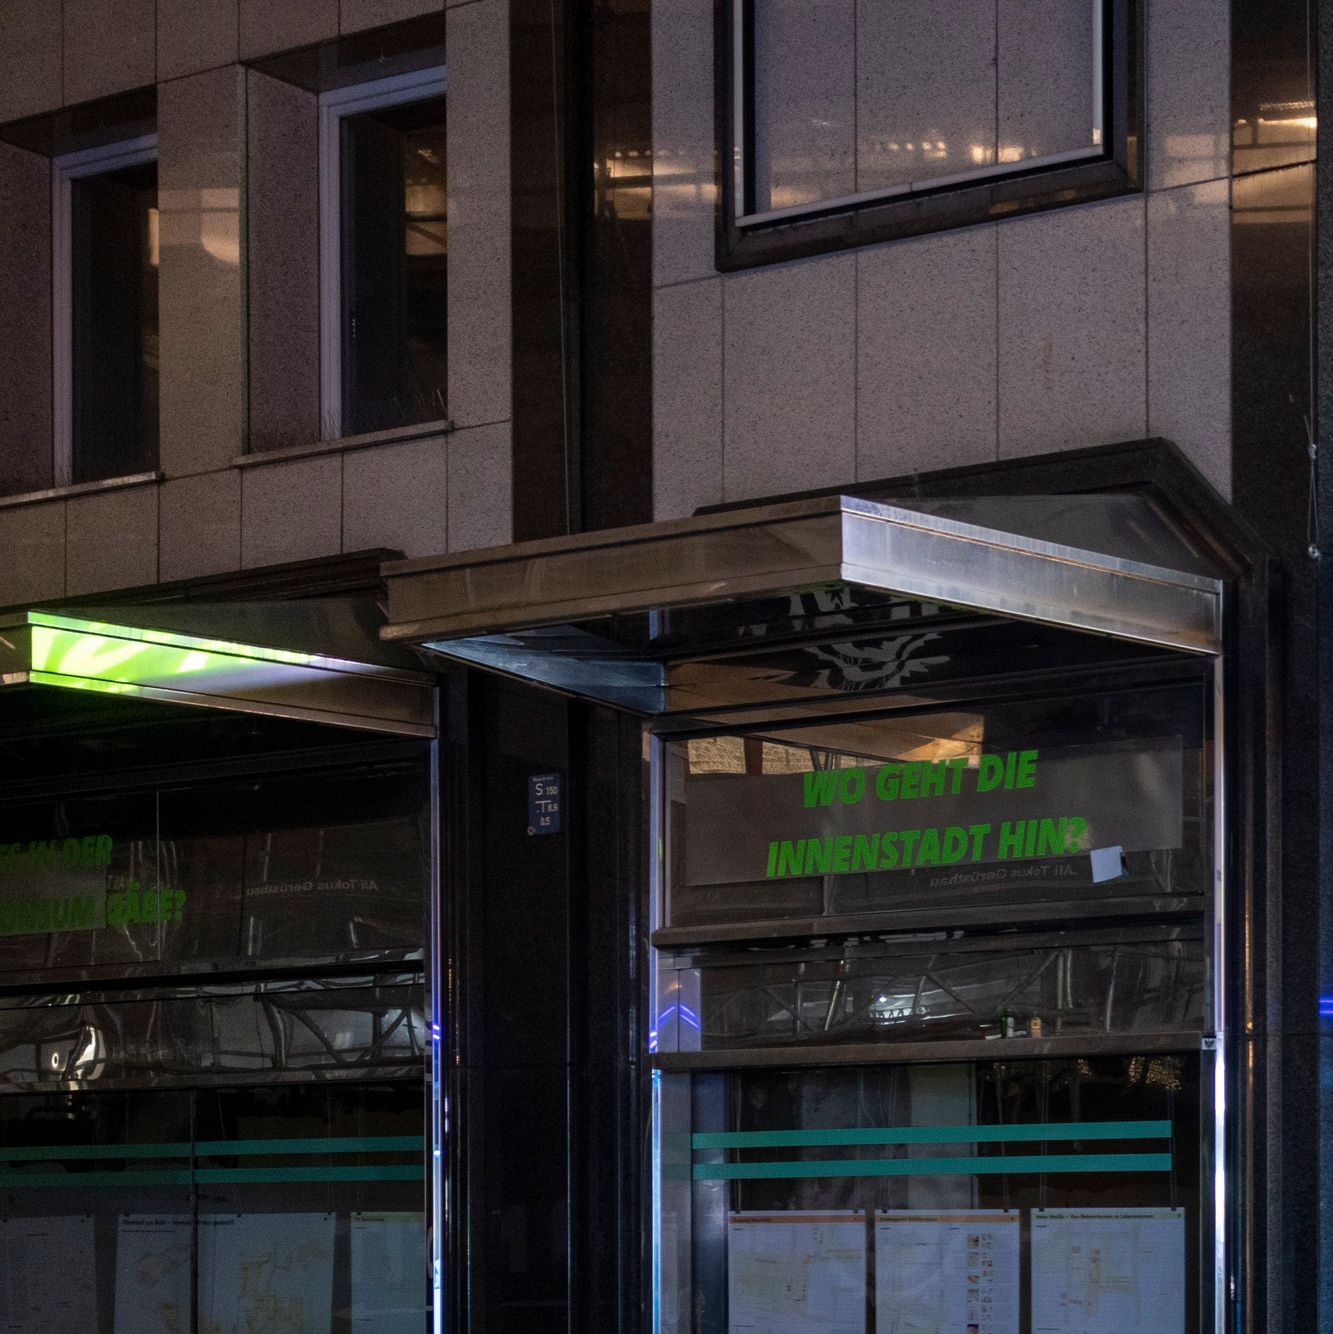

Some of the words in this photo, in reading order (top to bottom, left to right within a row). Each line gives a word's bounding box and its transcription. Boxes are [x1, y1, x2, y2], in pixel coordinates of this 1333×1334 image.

[535, 783, 544, 796] S
[802, 768, 865, 807] WO
[875, 757, 970, 801] GEHT
[976, 749, 1038, 793] DIE
[766, 823, 991, 878] INNENSTADT
[998, 815, 1087, 860] HIN?
